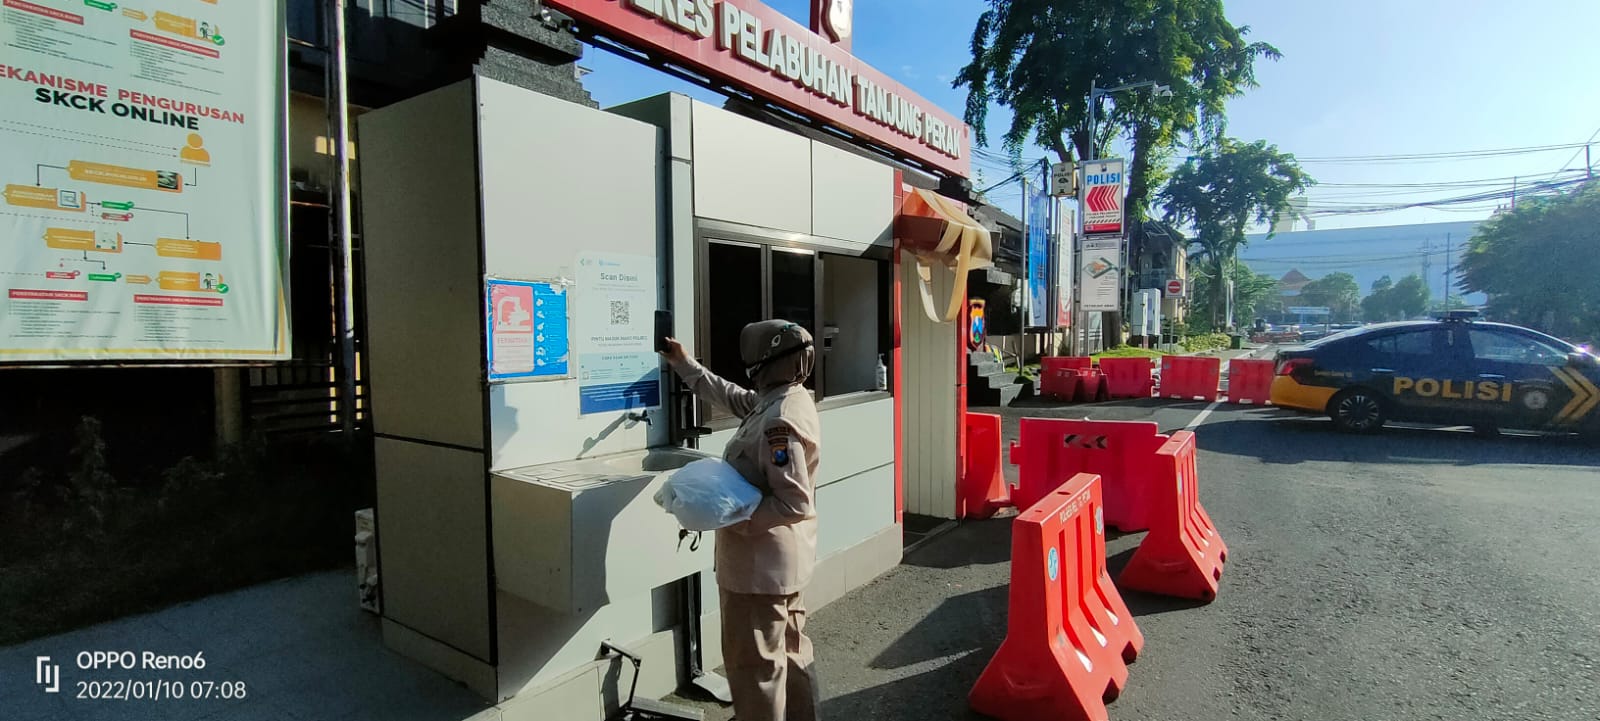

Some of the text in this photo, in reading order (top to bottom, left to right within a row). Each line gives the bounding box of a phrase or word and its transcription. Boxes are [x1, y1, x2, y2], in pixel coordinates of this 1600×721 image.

[723, 1, 851, 106] PELABUHAN
[857, 75, 922, 138] TANJUNG
[926, 113, 960, 158] PERAK
[35, 87, 199, 130] SKCK ONLINE
[118, 89, 245, 124] PENGURUSAN
[1086, 173, 1121, 185] POLISI
[600, 272, 617, 281] Scan
[1393, 376, 1513, 402] POLISI
